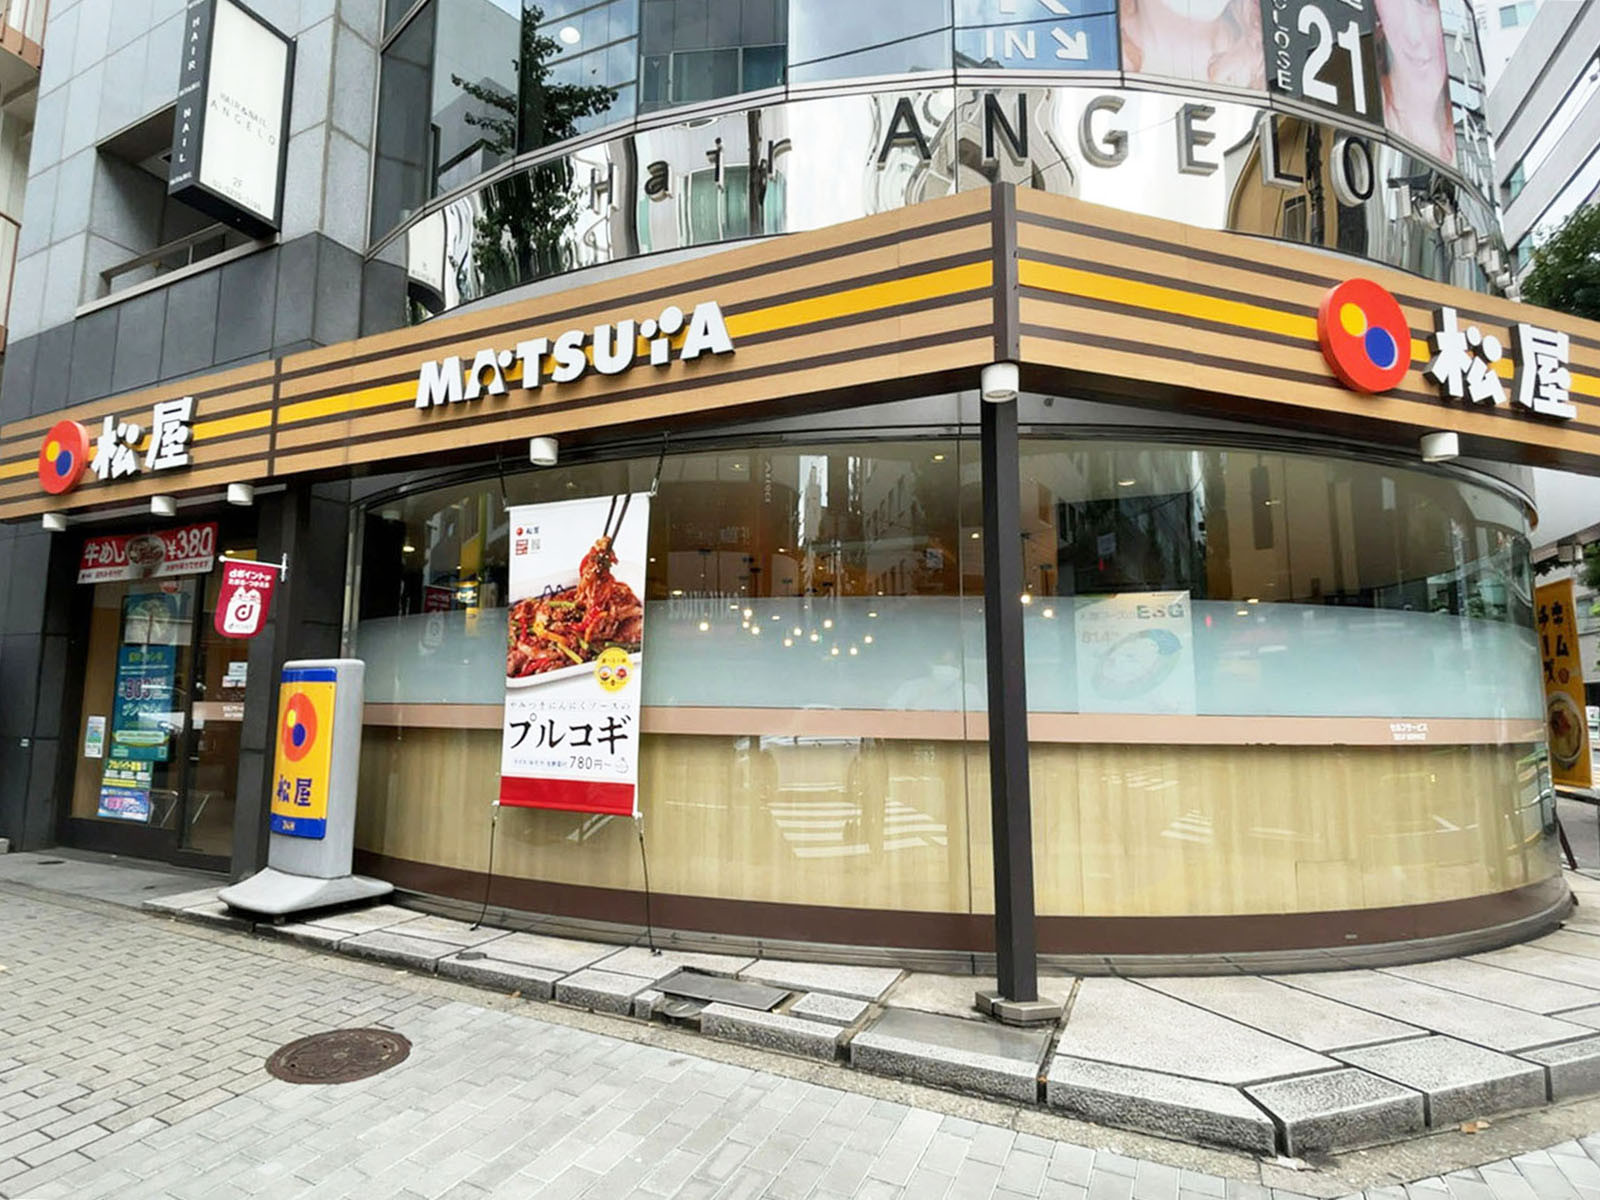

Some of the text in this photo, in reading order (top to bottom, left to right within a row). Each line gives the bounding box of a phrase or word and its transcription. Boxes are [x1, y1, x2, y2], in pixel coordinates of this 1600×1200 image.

[187, 16, 200, 71] HAIR
[985, 30, 1036, 58] IN
[1297, 4, 1367, 114] 21
[179, 107, 193, 163] NAIL
[210, 99, 277, 146] ANGELO
[588, 136, 793, 212] Hair
[876, 92, 1374, 207] ANGELO
[1424, 306, 1577, 420] 松屋
[90, 396, 194, 480] 松屋
[84, 526, 213, 567] 牛めし ¥380
[509, 711, 632, 755] プルコギ
[276, 774, 313, 807] 松屋
